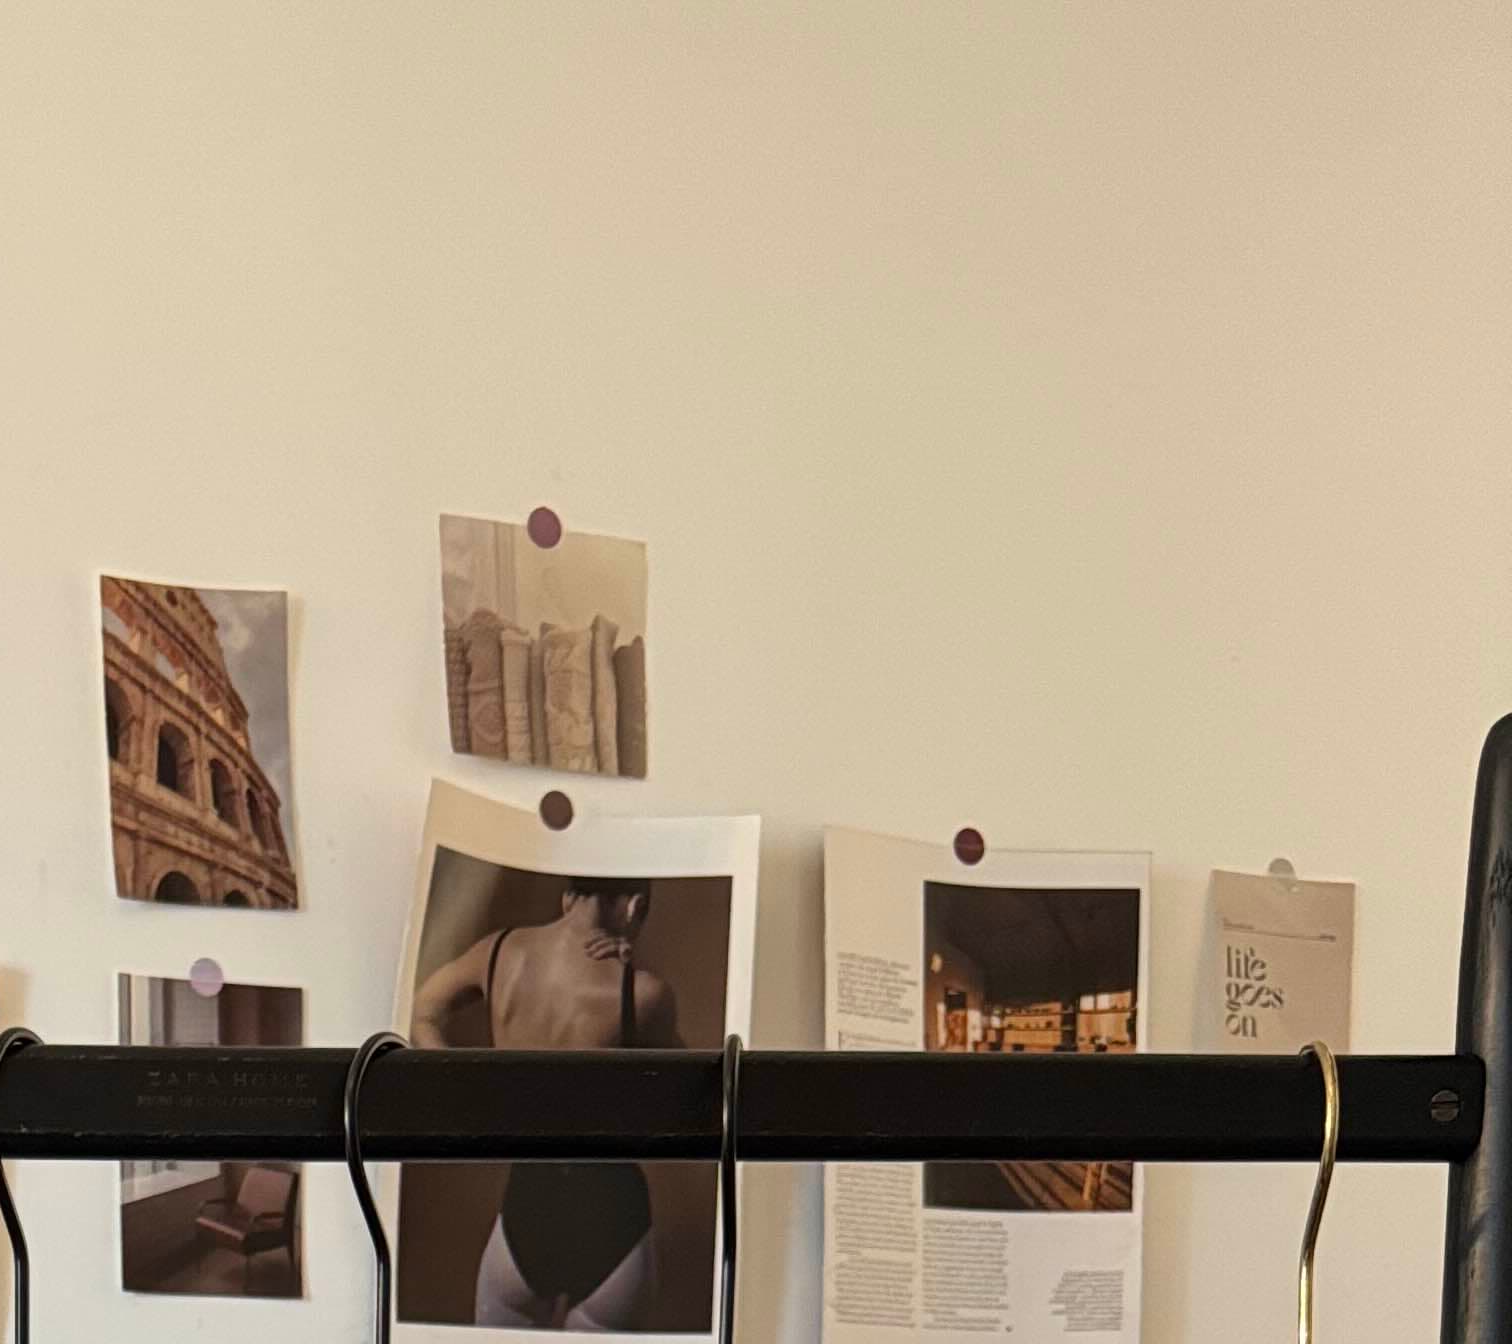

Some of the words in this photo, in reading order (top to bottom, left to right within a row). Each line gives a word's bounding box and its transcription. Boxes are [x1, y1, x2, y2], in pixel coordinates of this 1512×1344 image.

[1226, 945, 1267, 981] life
[1225, 982, 1284, 1011] goes
[1225, 1014, 1258, 1038] on
